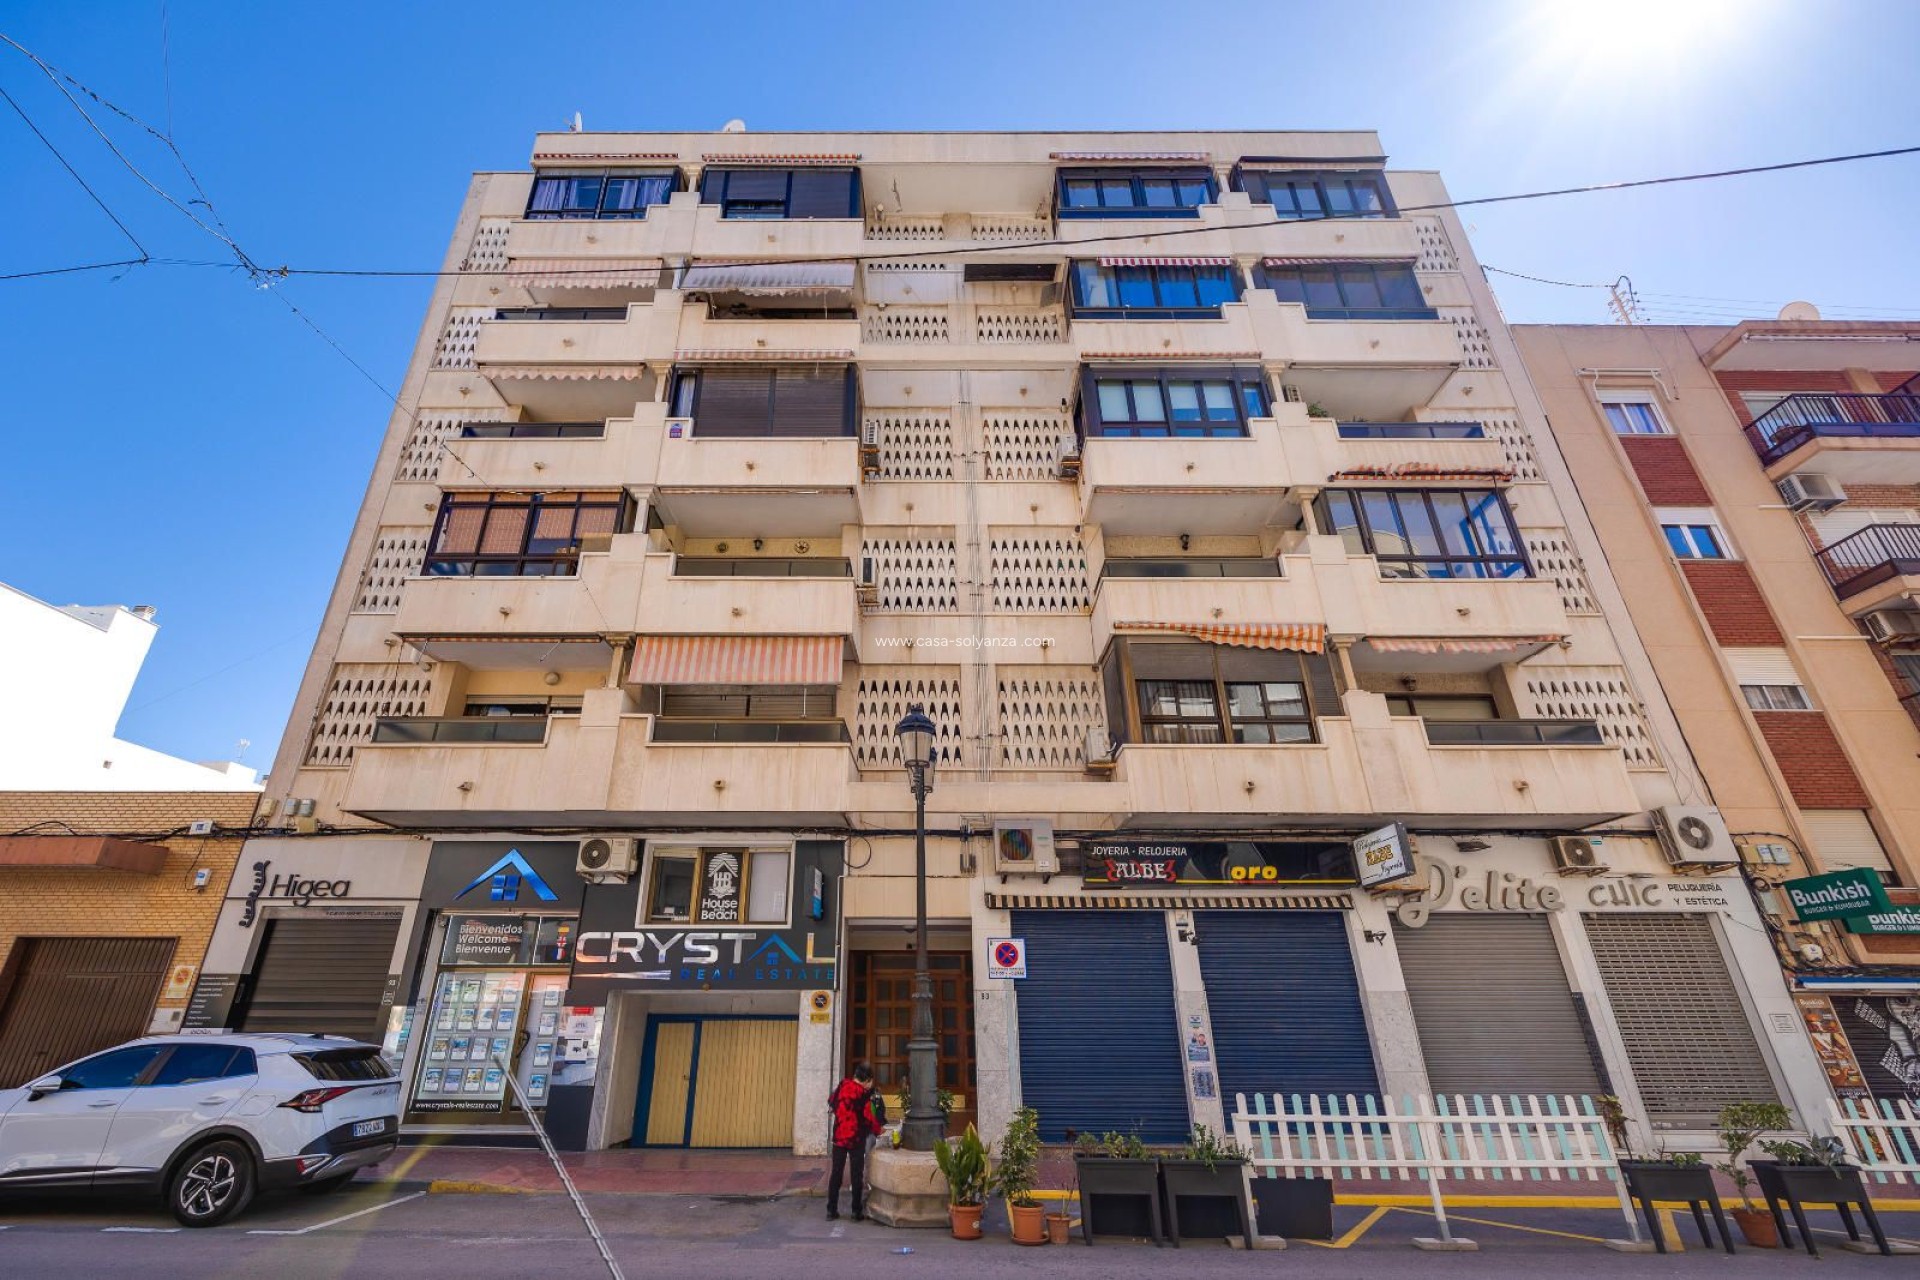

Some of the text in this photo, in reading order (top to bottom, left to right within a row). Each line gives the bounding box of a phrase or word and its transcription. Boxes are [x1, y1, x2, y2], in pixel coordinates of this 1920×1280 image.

[1092, 847, 1187, 855] JOYERIA RELOJERIA
[1115, 862, 1167, 879] ALBE
[1231, 865, 1278, 880] oro
[269, 874, 352, 908] Higea
[1790, 880, 1872, 907] Bunkish
[702, 898, 738, 908] House
[701, 909, 738, 920] Beach
[460, 924, 523, 934] Bienvenidos
[459, 934, 508, 944] Welcome
[455, 944, 511, 954] Bienvenue
[575, 931, 836, 963] CRYSTAL
[755, 968, 835, 980] ESTATE
